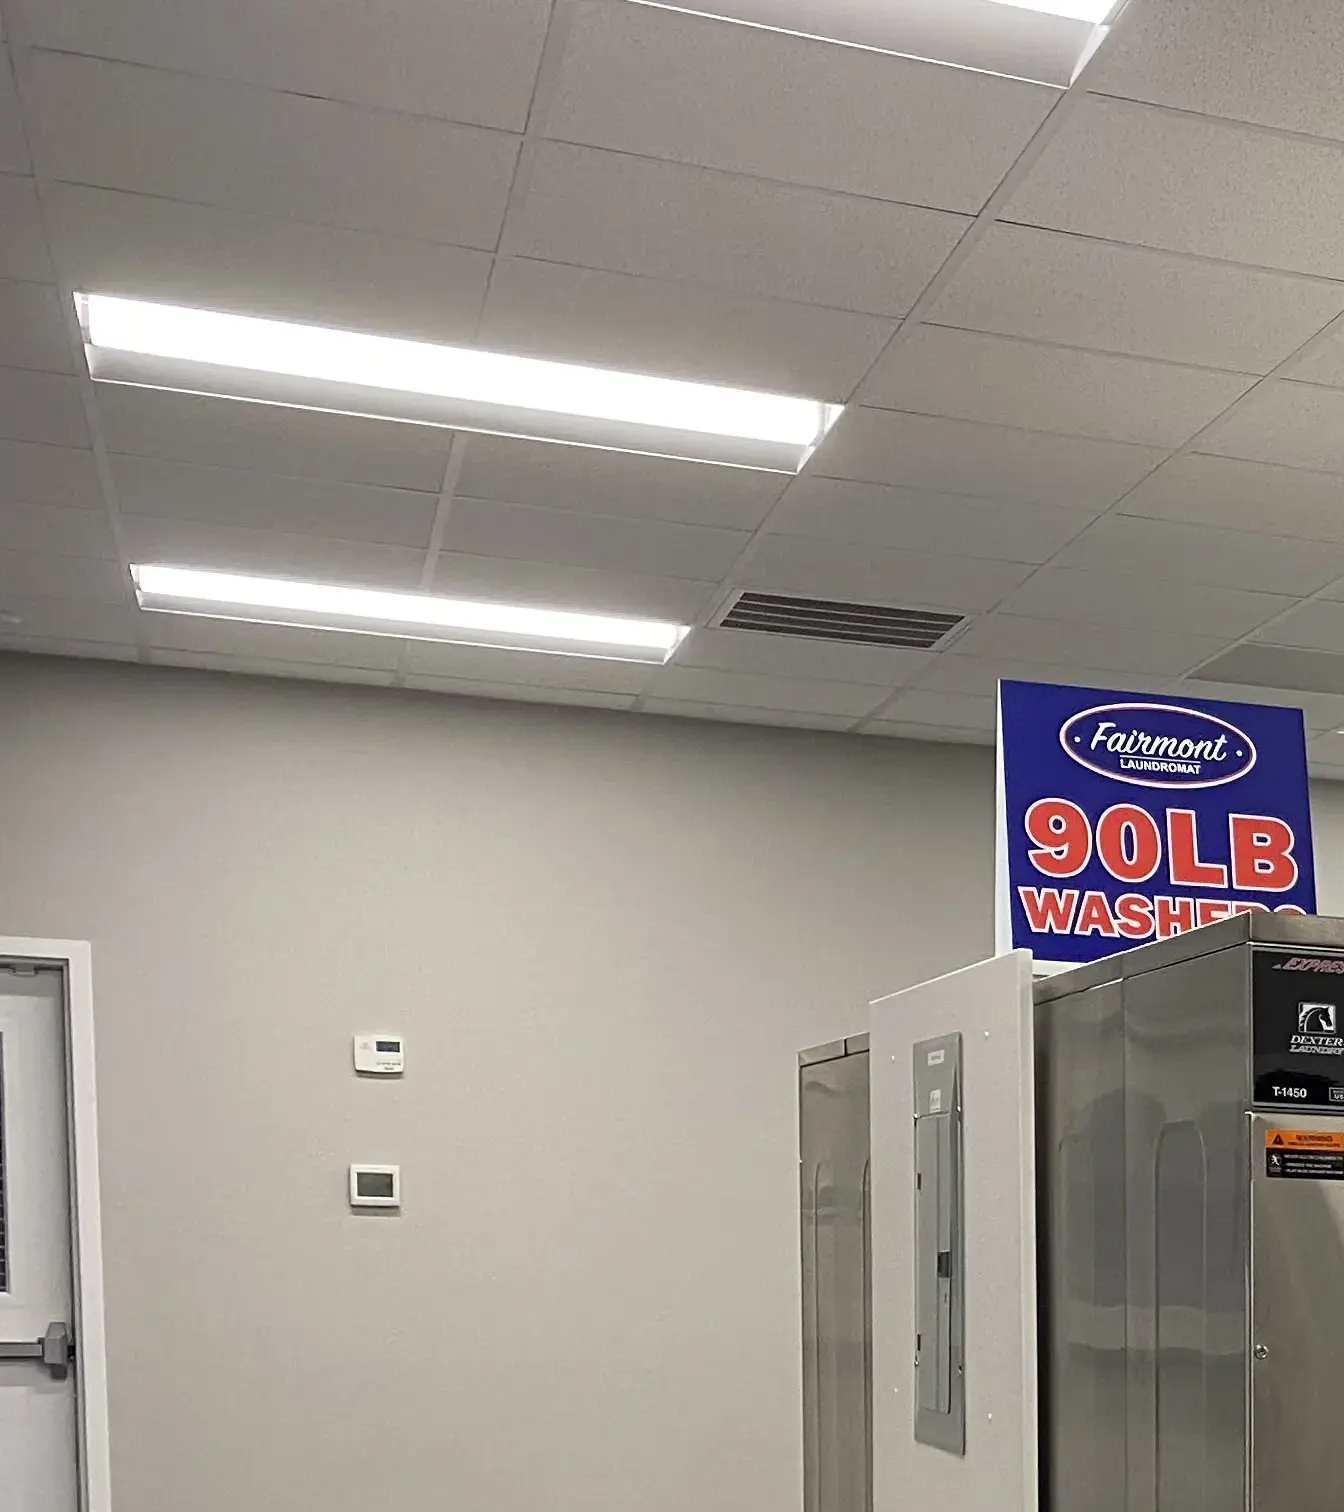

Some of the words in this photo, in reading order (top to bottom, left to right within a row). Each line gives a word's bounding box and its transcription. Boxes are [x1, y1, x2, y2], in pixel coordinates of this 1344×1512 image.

[1090, 722, 1228, 761] Fairmont
[1119, 759, 1201, 775] LAUNDROMAT
[1025, 797, 1299, 893] 90LB
[1018, 886, 1307, 939] WASHE
[1290, 1034, 1344, 1047] DEXTER
[1272, 1086, 1307, 1098] T-1450
